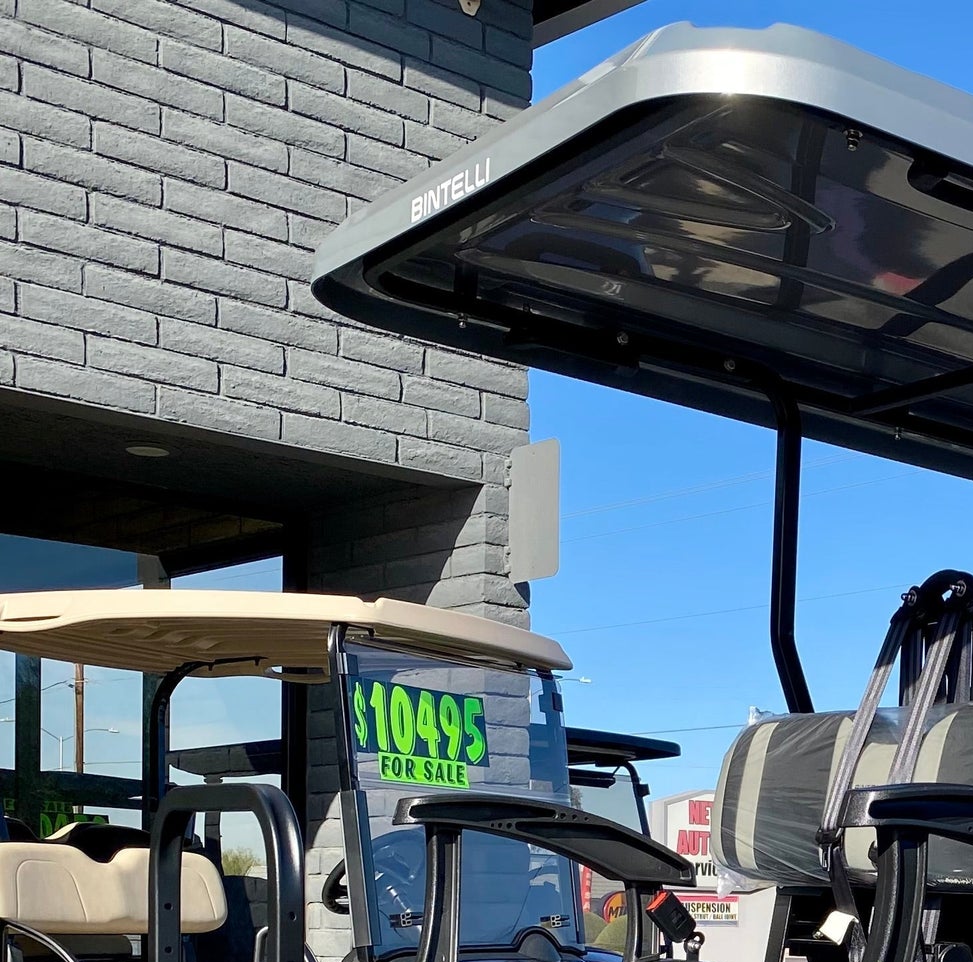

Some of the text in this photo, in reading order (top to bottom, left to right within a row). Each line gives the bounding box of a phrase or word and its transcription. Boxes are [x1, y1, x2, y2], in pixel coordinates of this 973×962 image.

[411, 157, 490, 223] BINTELLI
[354, 681, 486, 765] $10495
[381, 755, 466, 786] FOR SALE
[681, 902, 731, 914] USPENSION
